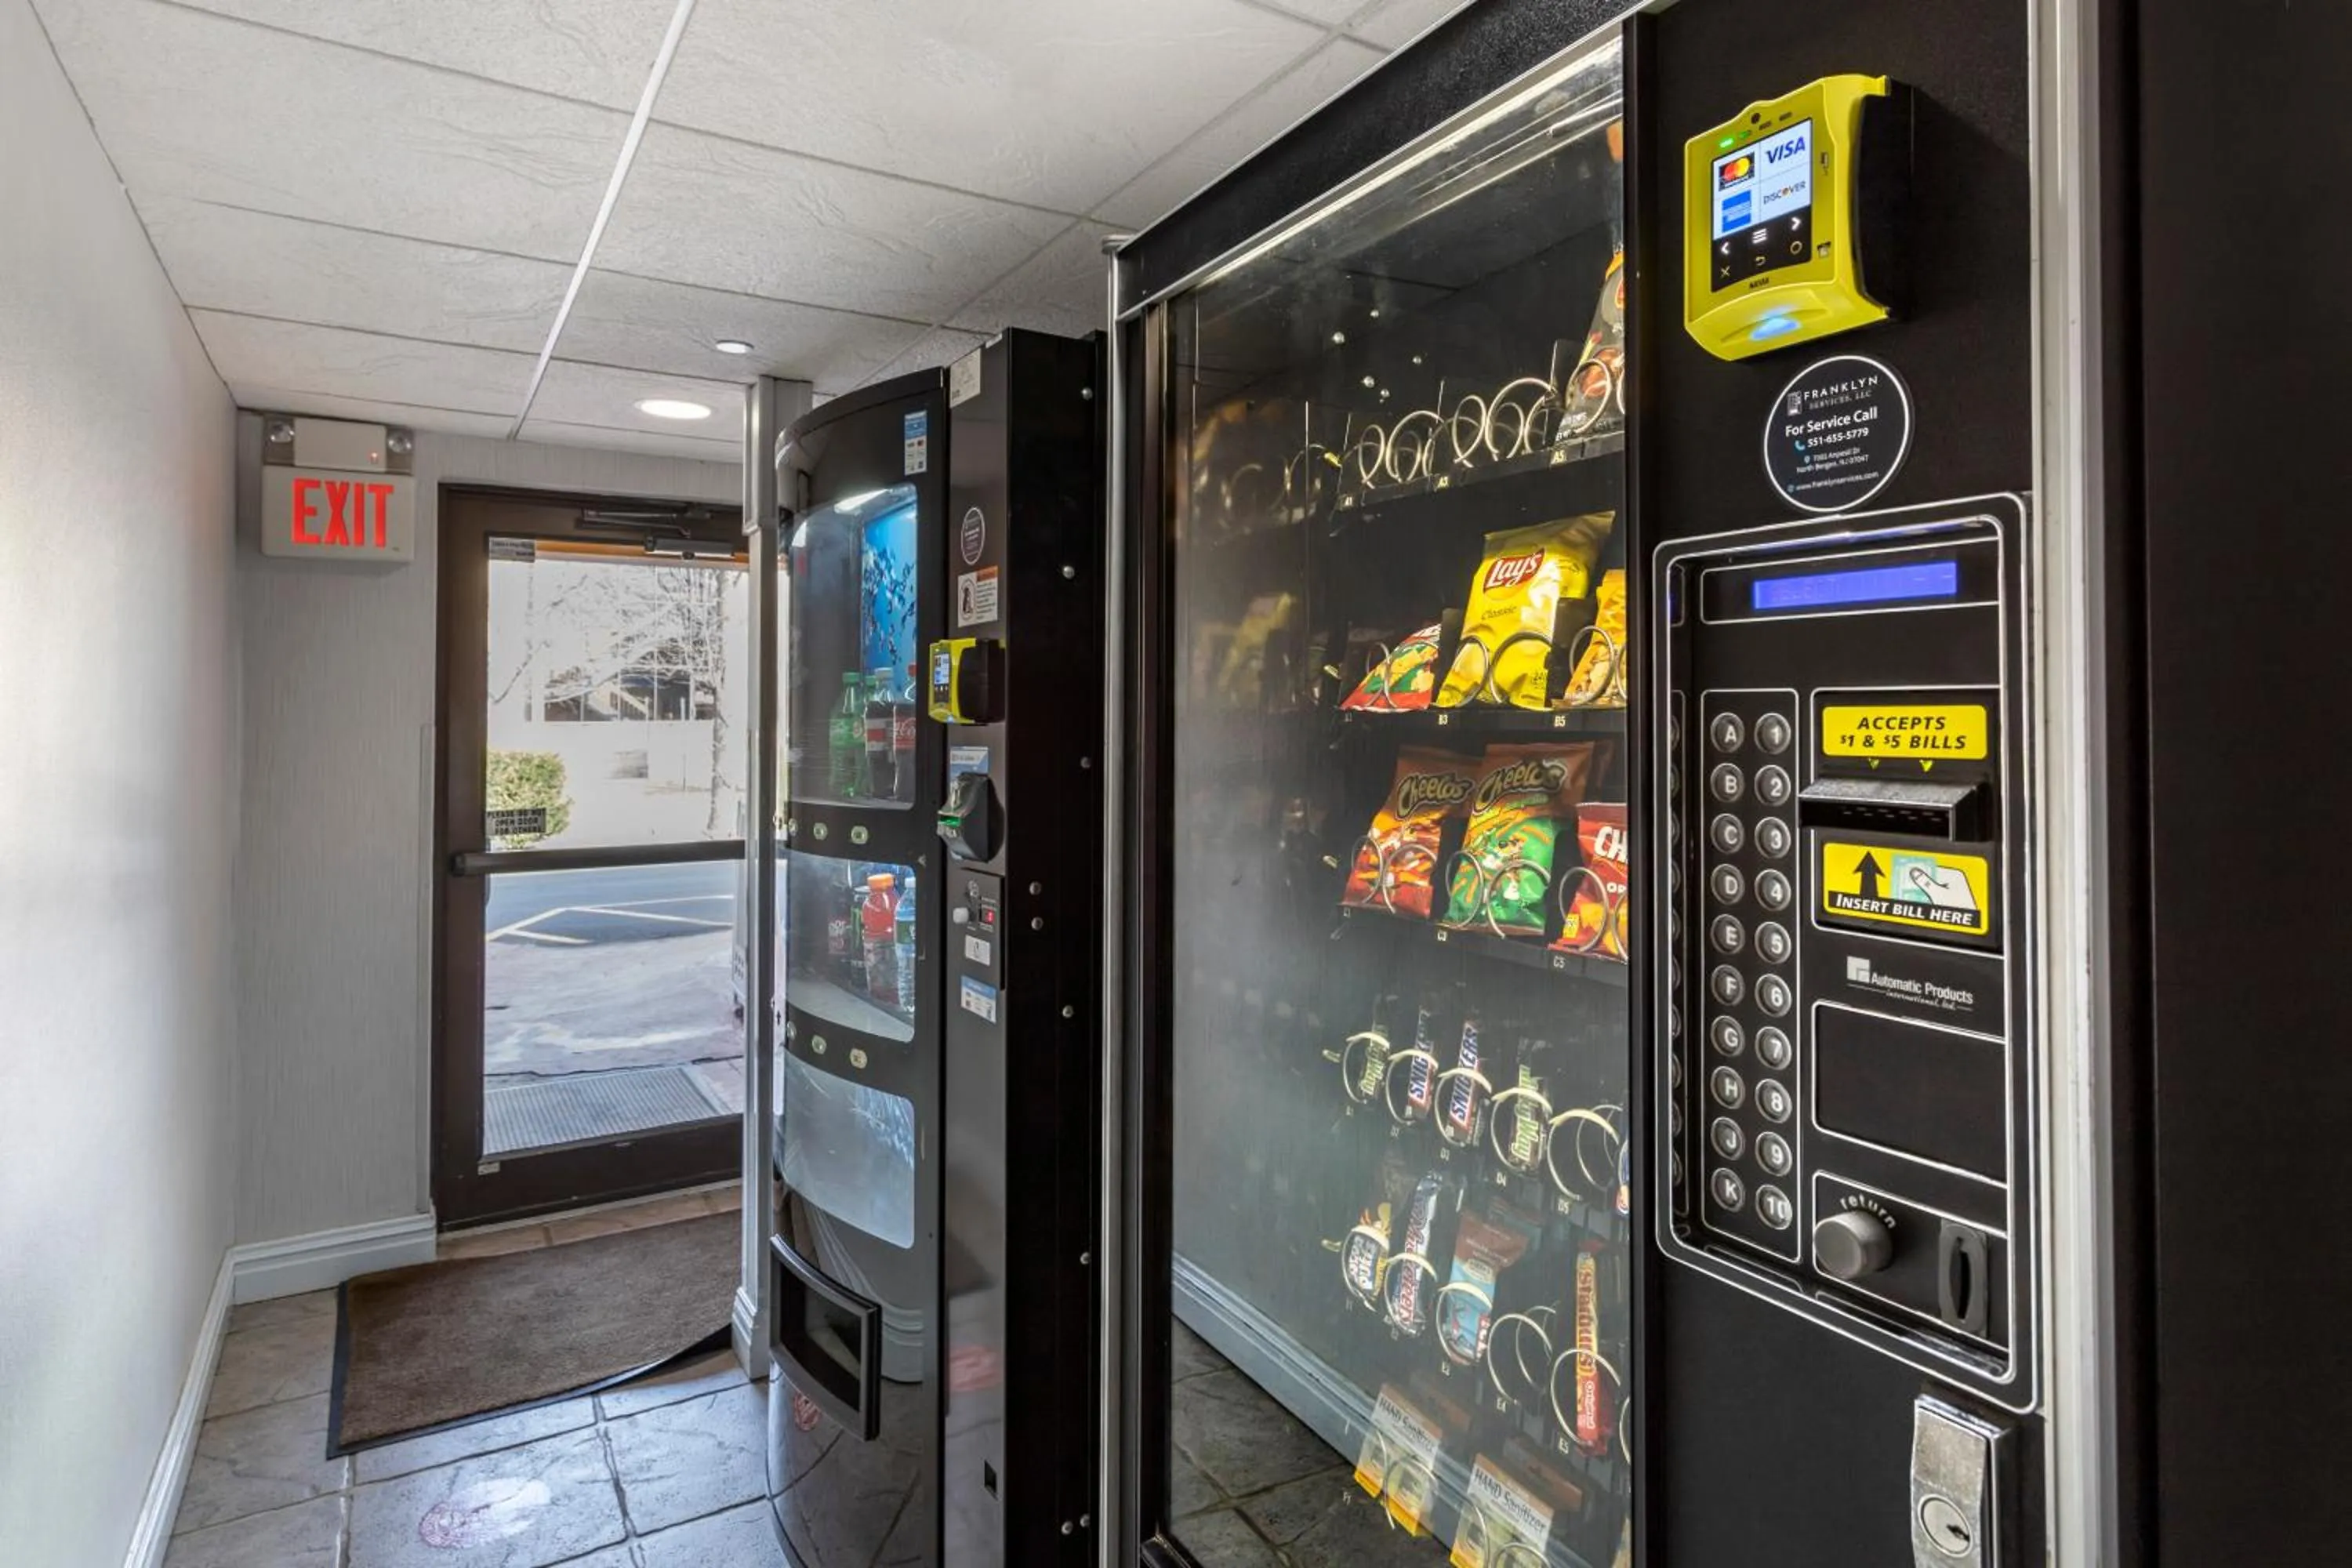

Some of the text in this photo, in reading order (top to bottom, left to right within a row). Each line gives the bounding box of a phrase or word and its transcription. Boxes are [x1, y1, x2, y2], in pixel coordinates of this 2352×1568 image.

[1766, 136, 1806, 164] VISA
[1763, 181, 1806, 205] DISCOVER
[1804, 376, 1878, 401] FRANKLYN
[1785, 405, 1878, 437] For Service Call
[1807, 427, 1869, 448] 551-655-5779
[292, 477, 394, 548] EXIT
[1485, 554, 1542, 588] Lay's
[1481, 604, 1517, 620] Classic
[1554, 715, 1566, 728] B5
[1725, 725, 1780, 743] A 1
[1857, 717, 1946, 730] ACCEPTS
[1840, 735, 1966, 749] $1 & $5 BILLS
[1398, 774, 1471, 817] Cheetos
[1725, 775, 1782, 797] B 2
[495, 827, 509, 836] FOR
[518, 817, 538, 826] DOOR
[1725, 826, 1782, 848] C 3
[1726, 876, 1782, 902] D 4
[1836, 894, 1973, 926] INSERT BILL HERE
[1726, 927, 1782, 953] E 5
[1726, 977, 1783, 1007] F 6
[1871, 972, 1973, 1004] Automatic Products
[1725, 1027, 1782, 1059] G 7
[1725, 1078, 1783, 1113] H 8
[1726, 1131, 1783, 1166] J 9
[1726, 1180, 1791, 1218] K 10
[1840, 1193, 1896, 1229] return
[1475, 1467, 1502, 1499] HAND
